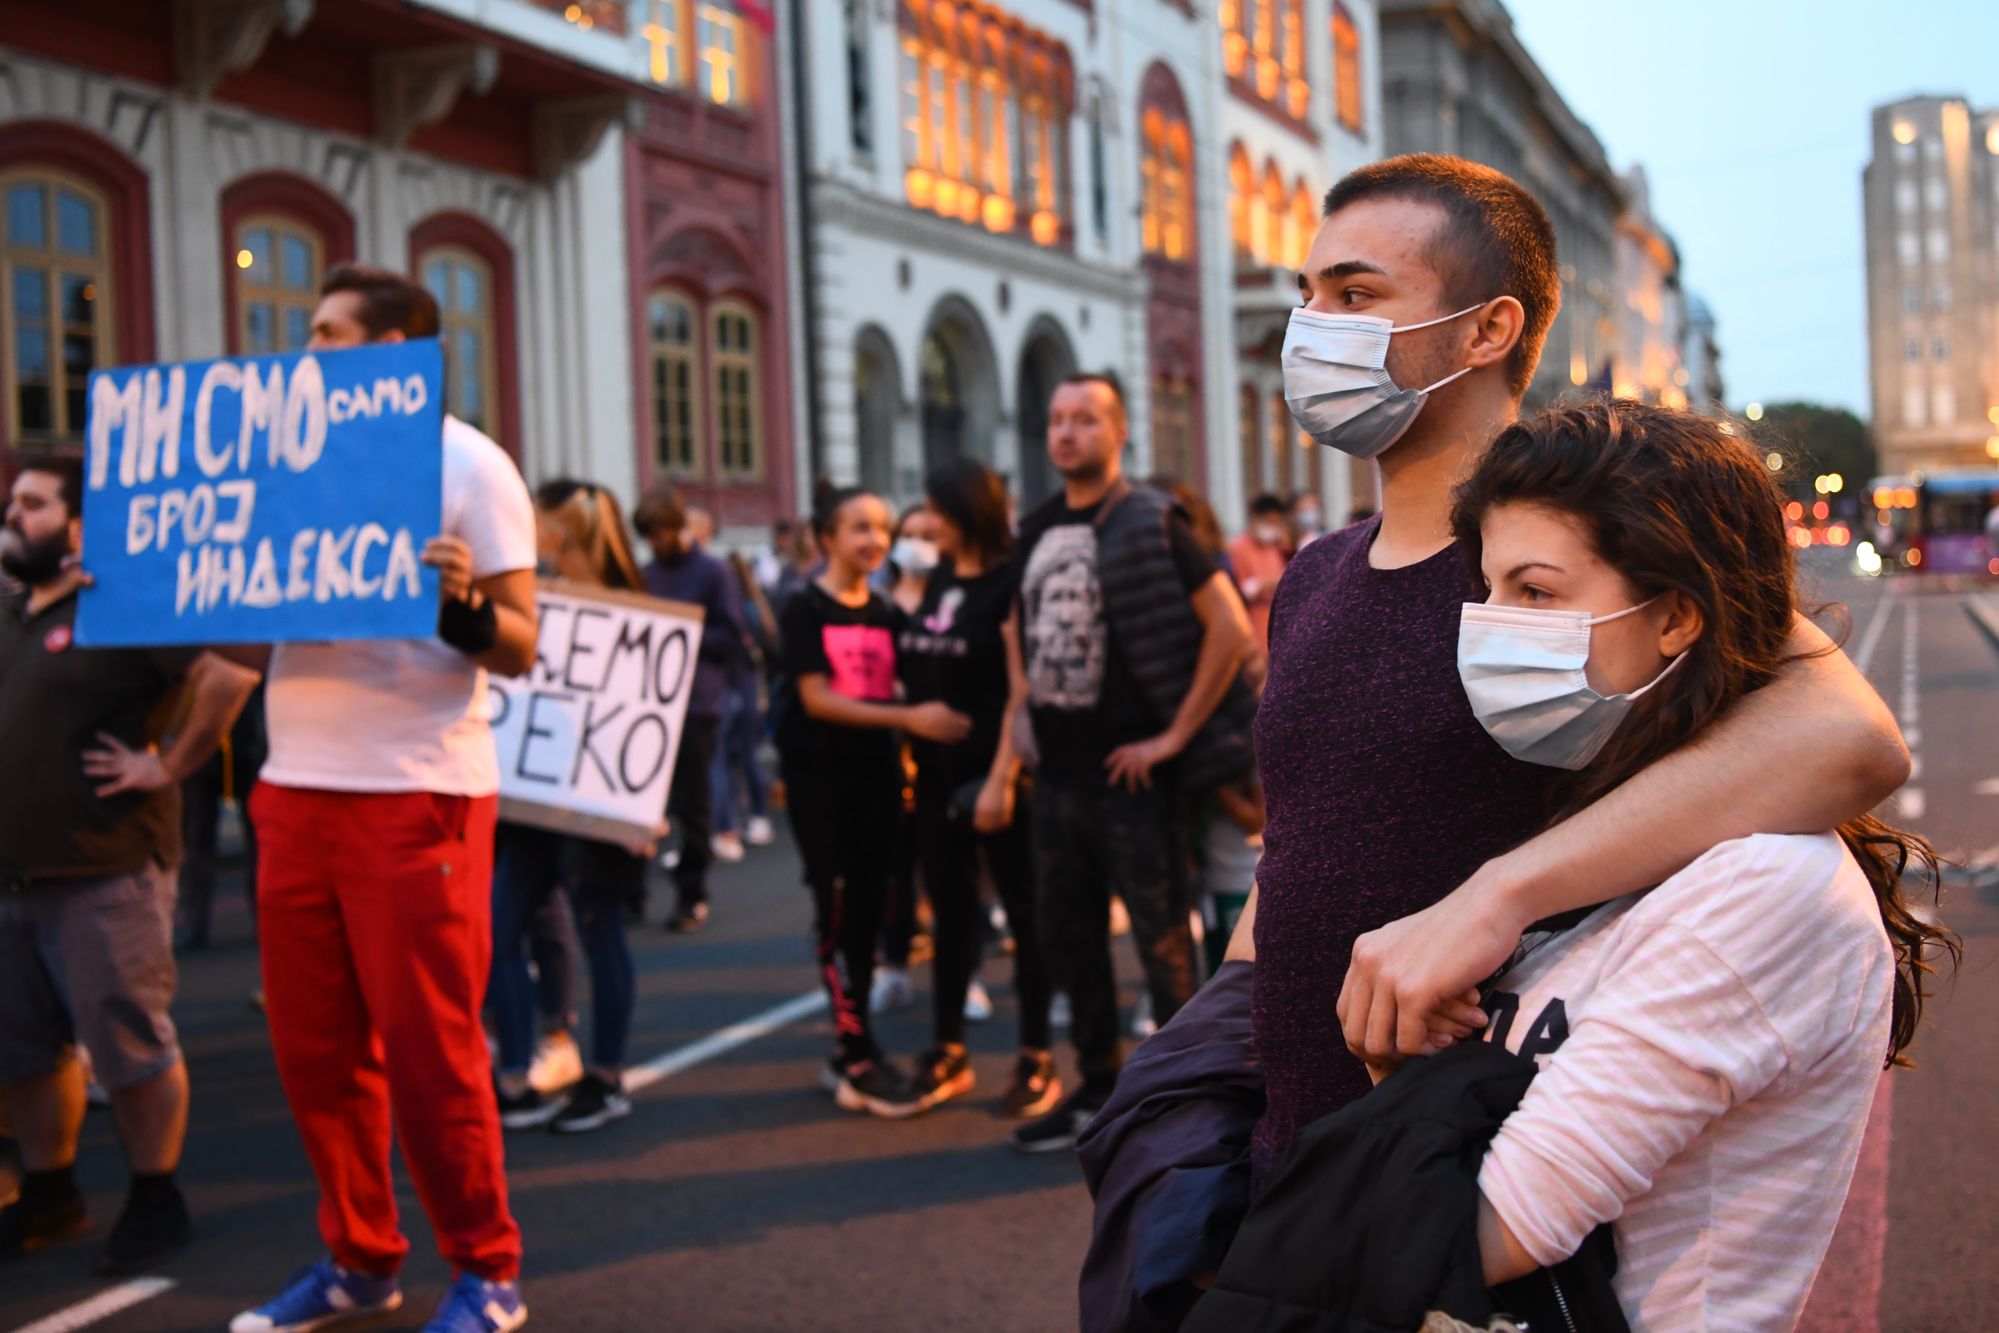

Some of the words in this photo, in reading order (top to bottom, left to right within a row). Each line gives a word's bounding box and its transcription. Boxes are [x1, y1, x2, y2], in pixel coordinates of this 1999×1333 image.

[193, 354, 329, 478] СМО
[328, 373, 428, 424] САМО
[126, 478, 257, 556] БРОЈ
[175, 522, 422, 618] ИНДЕКСА
